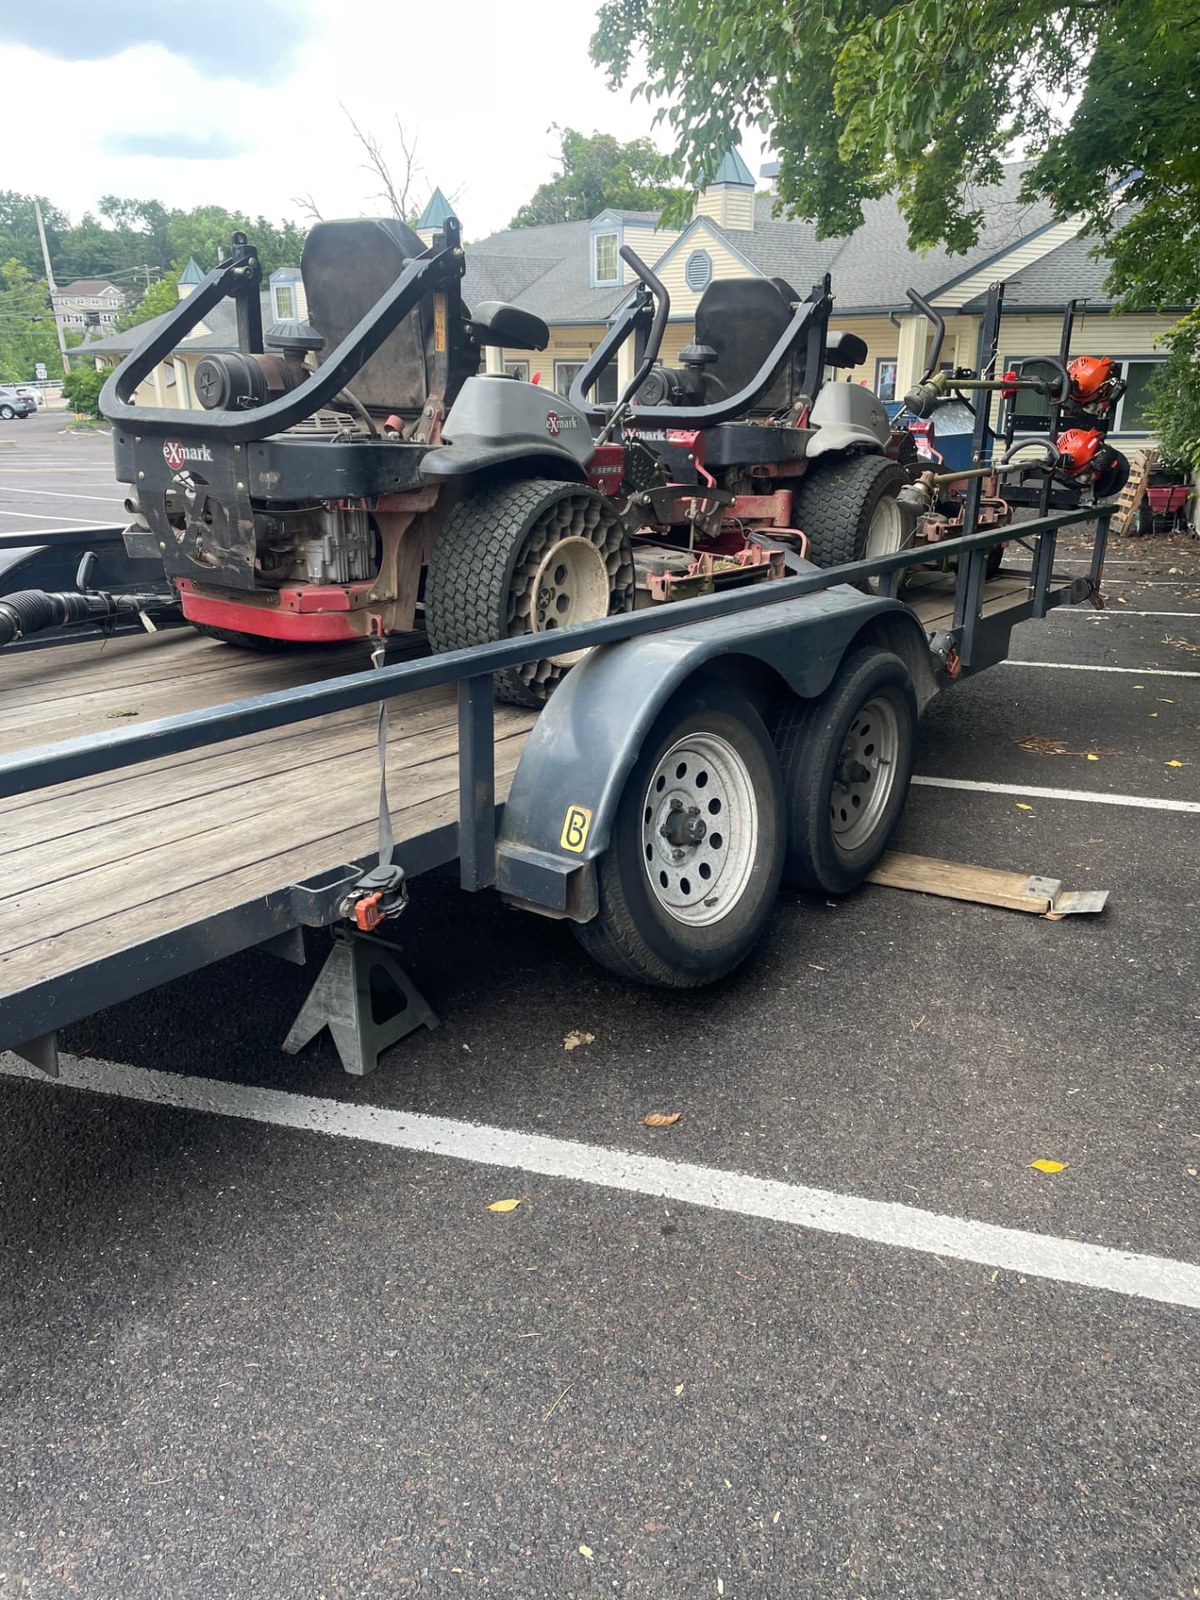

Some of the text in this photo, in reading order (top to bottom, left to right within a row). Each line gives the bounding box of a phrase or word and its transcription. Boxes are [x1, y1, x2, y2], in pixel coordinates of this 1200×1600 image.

[545, 416, 577, 433] eXmark
[162, 441, 214, 464] eXmark
[566, 809, 587, 848] B
